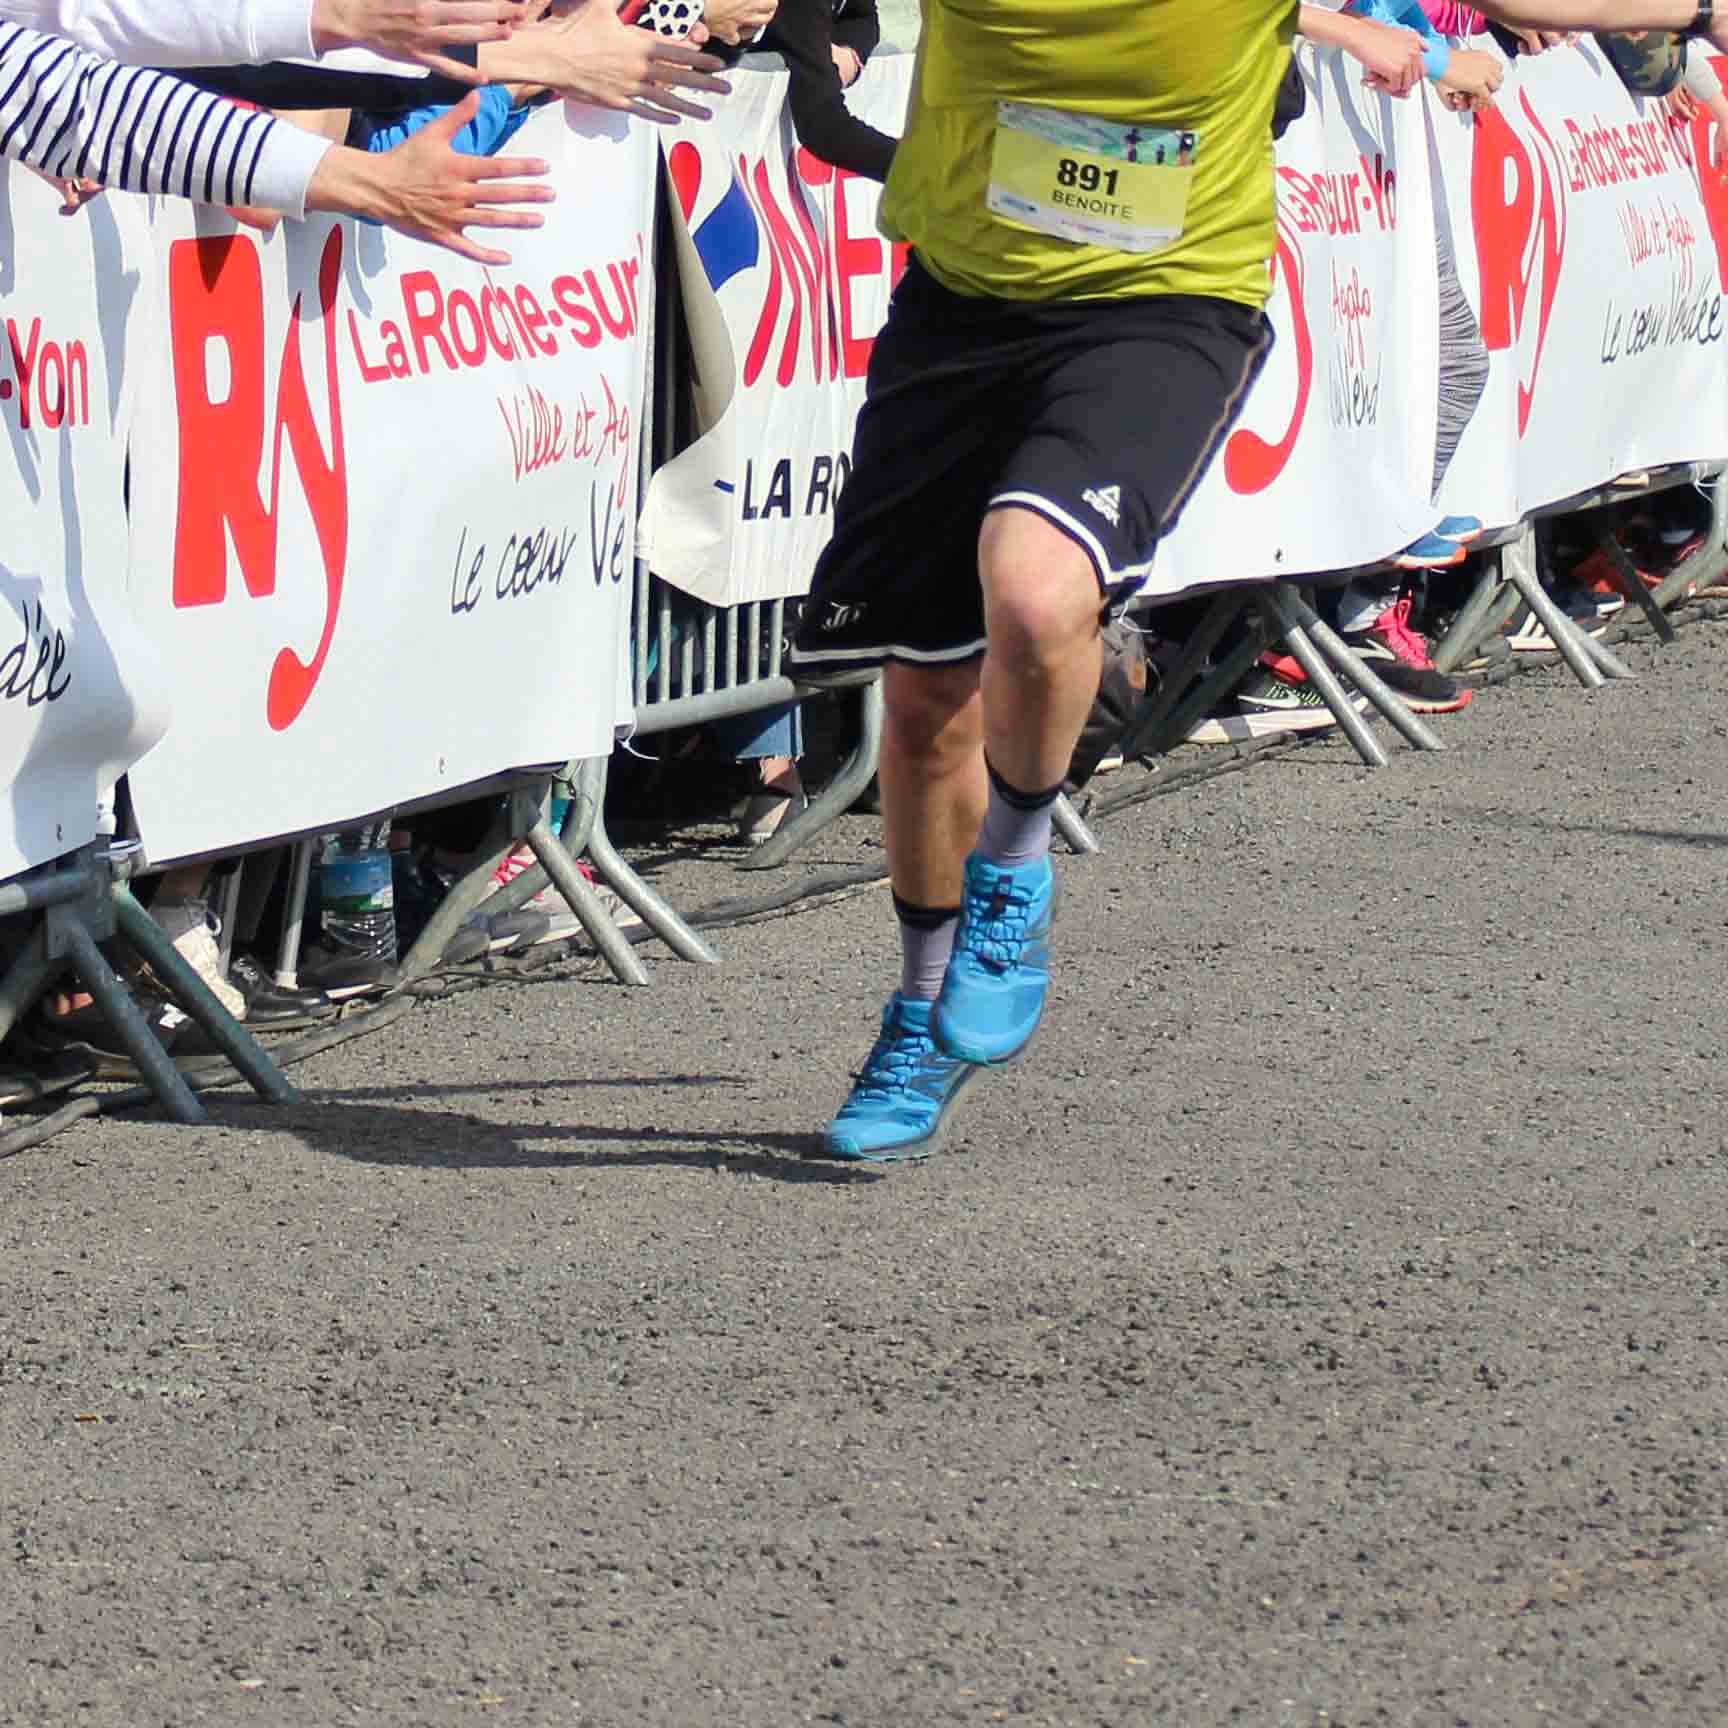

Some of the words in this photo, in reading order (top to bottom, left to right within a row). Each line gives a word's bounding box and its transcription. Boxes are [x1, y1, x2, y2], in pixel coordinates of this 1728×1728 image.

[1051, 189, 1134, 218] BENOITE
[1056, 158, 1119, 196] 891
[497, 383, 569, 484] Ville
[573, 391, 596, 459] et
[593, 372, 631, 509] Ag
[742, 456, 792, 522] LA
[450, 525, 486, 615] Le
[590, 479, 625, 587] Ve
